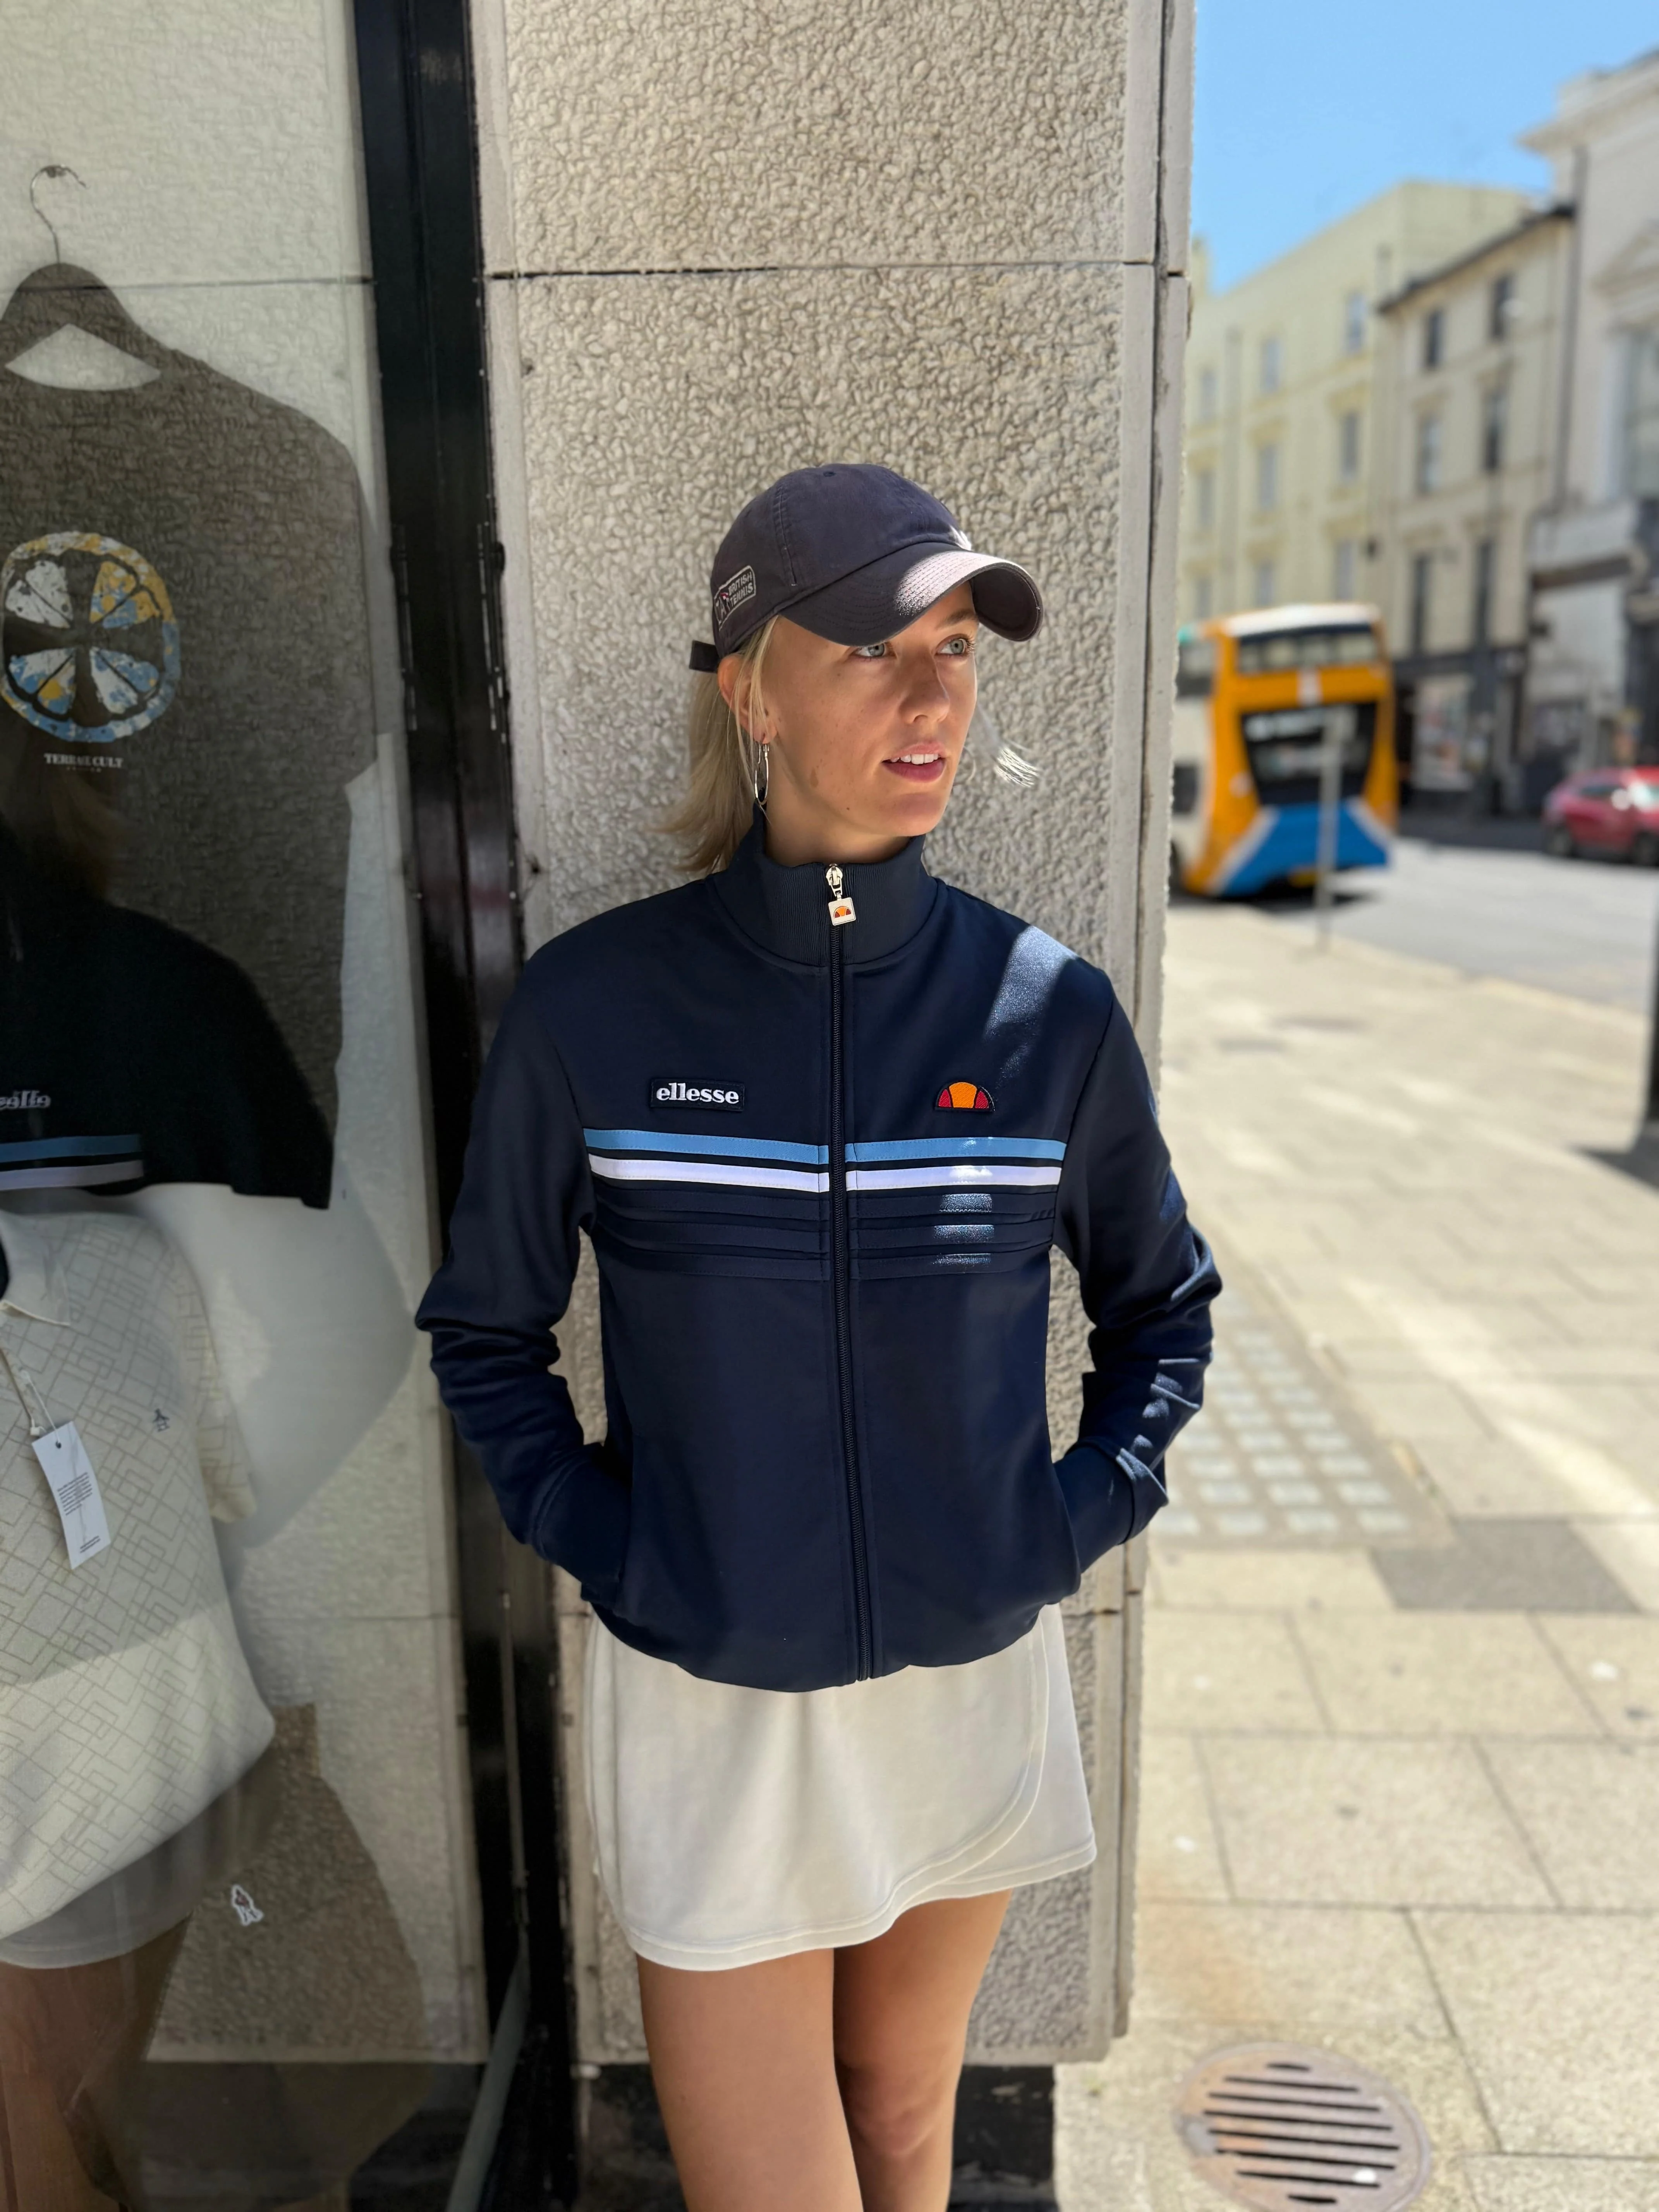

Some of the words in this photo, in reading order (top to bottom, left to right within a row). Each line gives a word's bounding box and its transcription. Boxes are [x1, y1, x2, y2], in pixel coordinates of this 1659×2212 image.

[728, 571, 752, 596] BRITISH
[730, 582, 753, 608] TENNIS
[92, 756, 124, 768] CULT
[656, 1082, 739, 1104] ellesse
